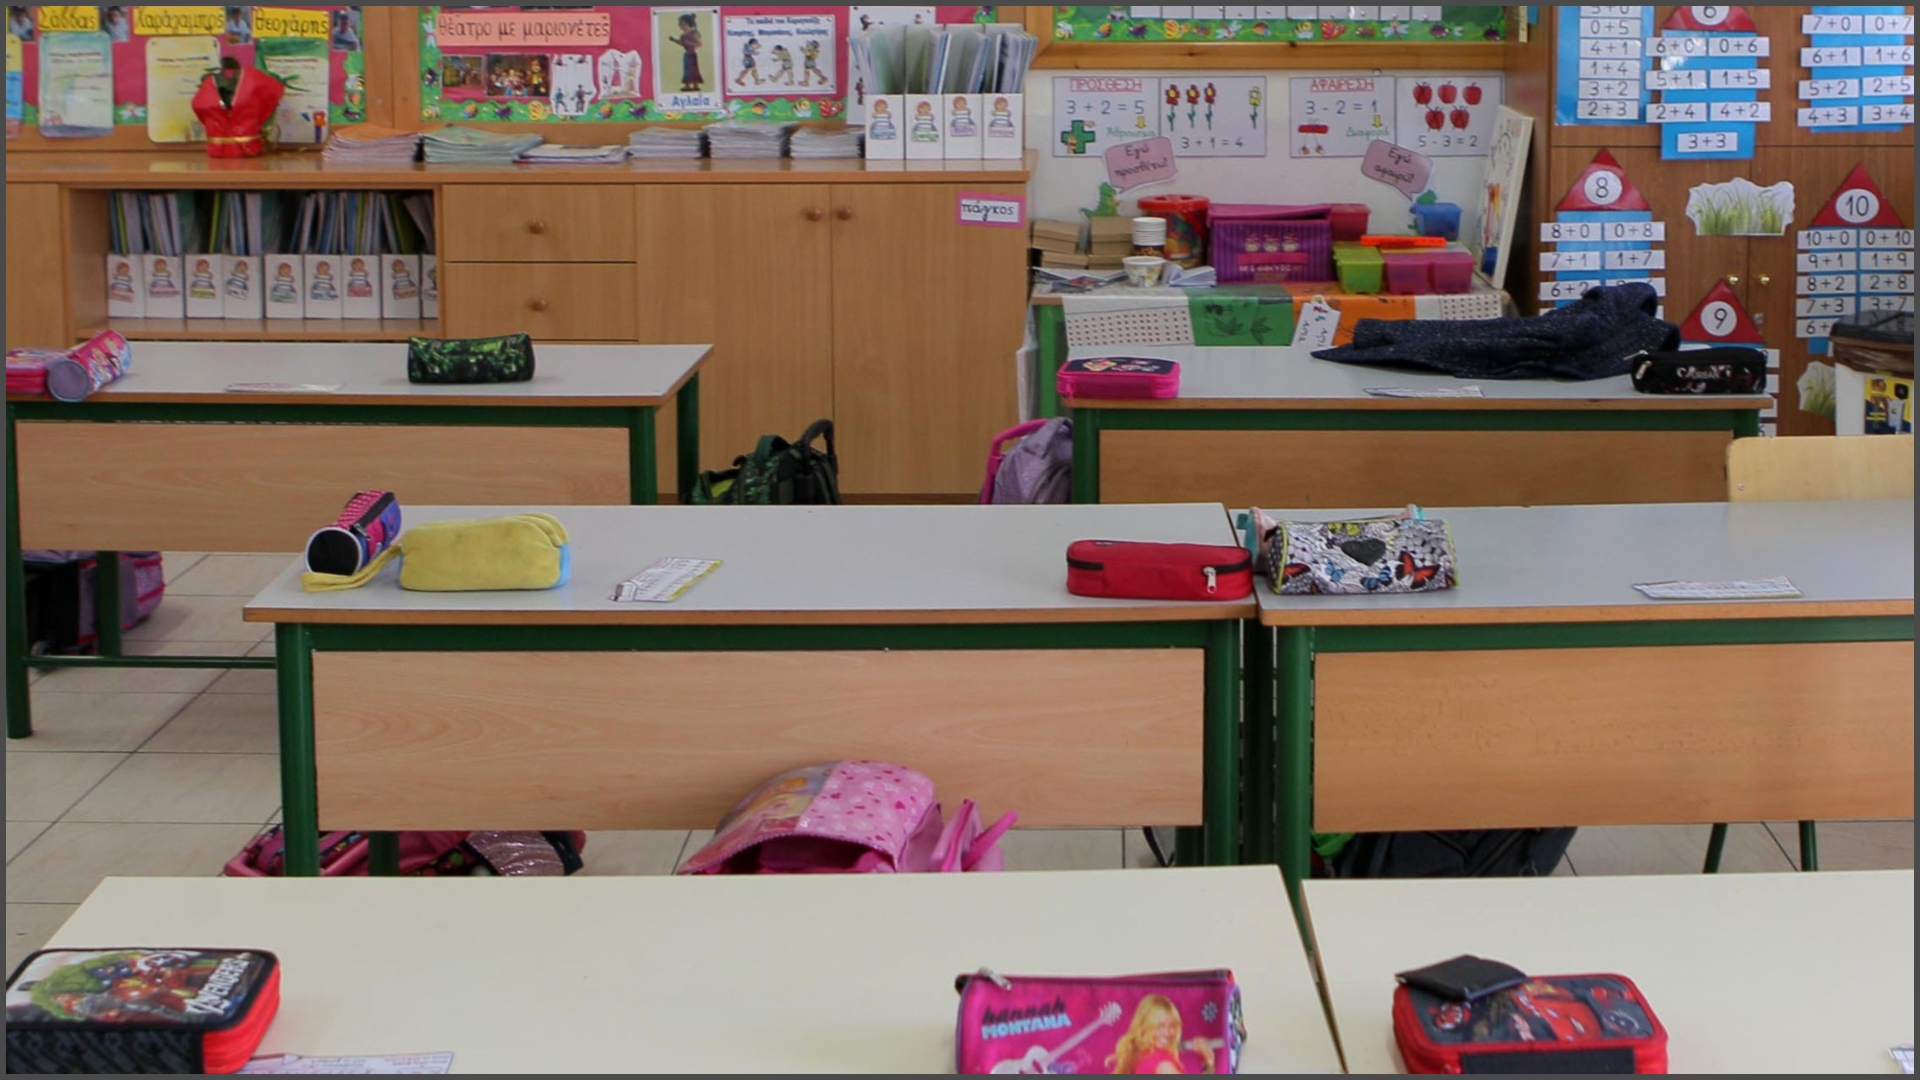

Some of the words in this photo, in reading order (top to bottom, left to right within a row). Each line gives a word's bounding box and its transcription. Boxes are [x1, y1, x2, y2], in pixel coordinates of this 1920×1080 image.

[499, 22, 516, 41] με
[1595, 176, 1609, 198] 8
[961, 200, 1014, 222] πάγκος
[1845, 195, 1869, 217] 10
[1714, 308, 1728, 330] 9
[982, 995, 1066, 1026] hannah
[981, 1012, 1072, 1040] MONTANA
